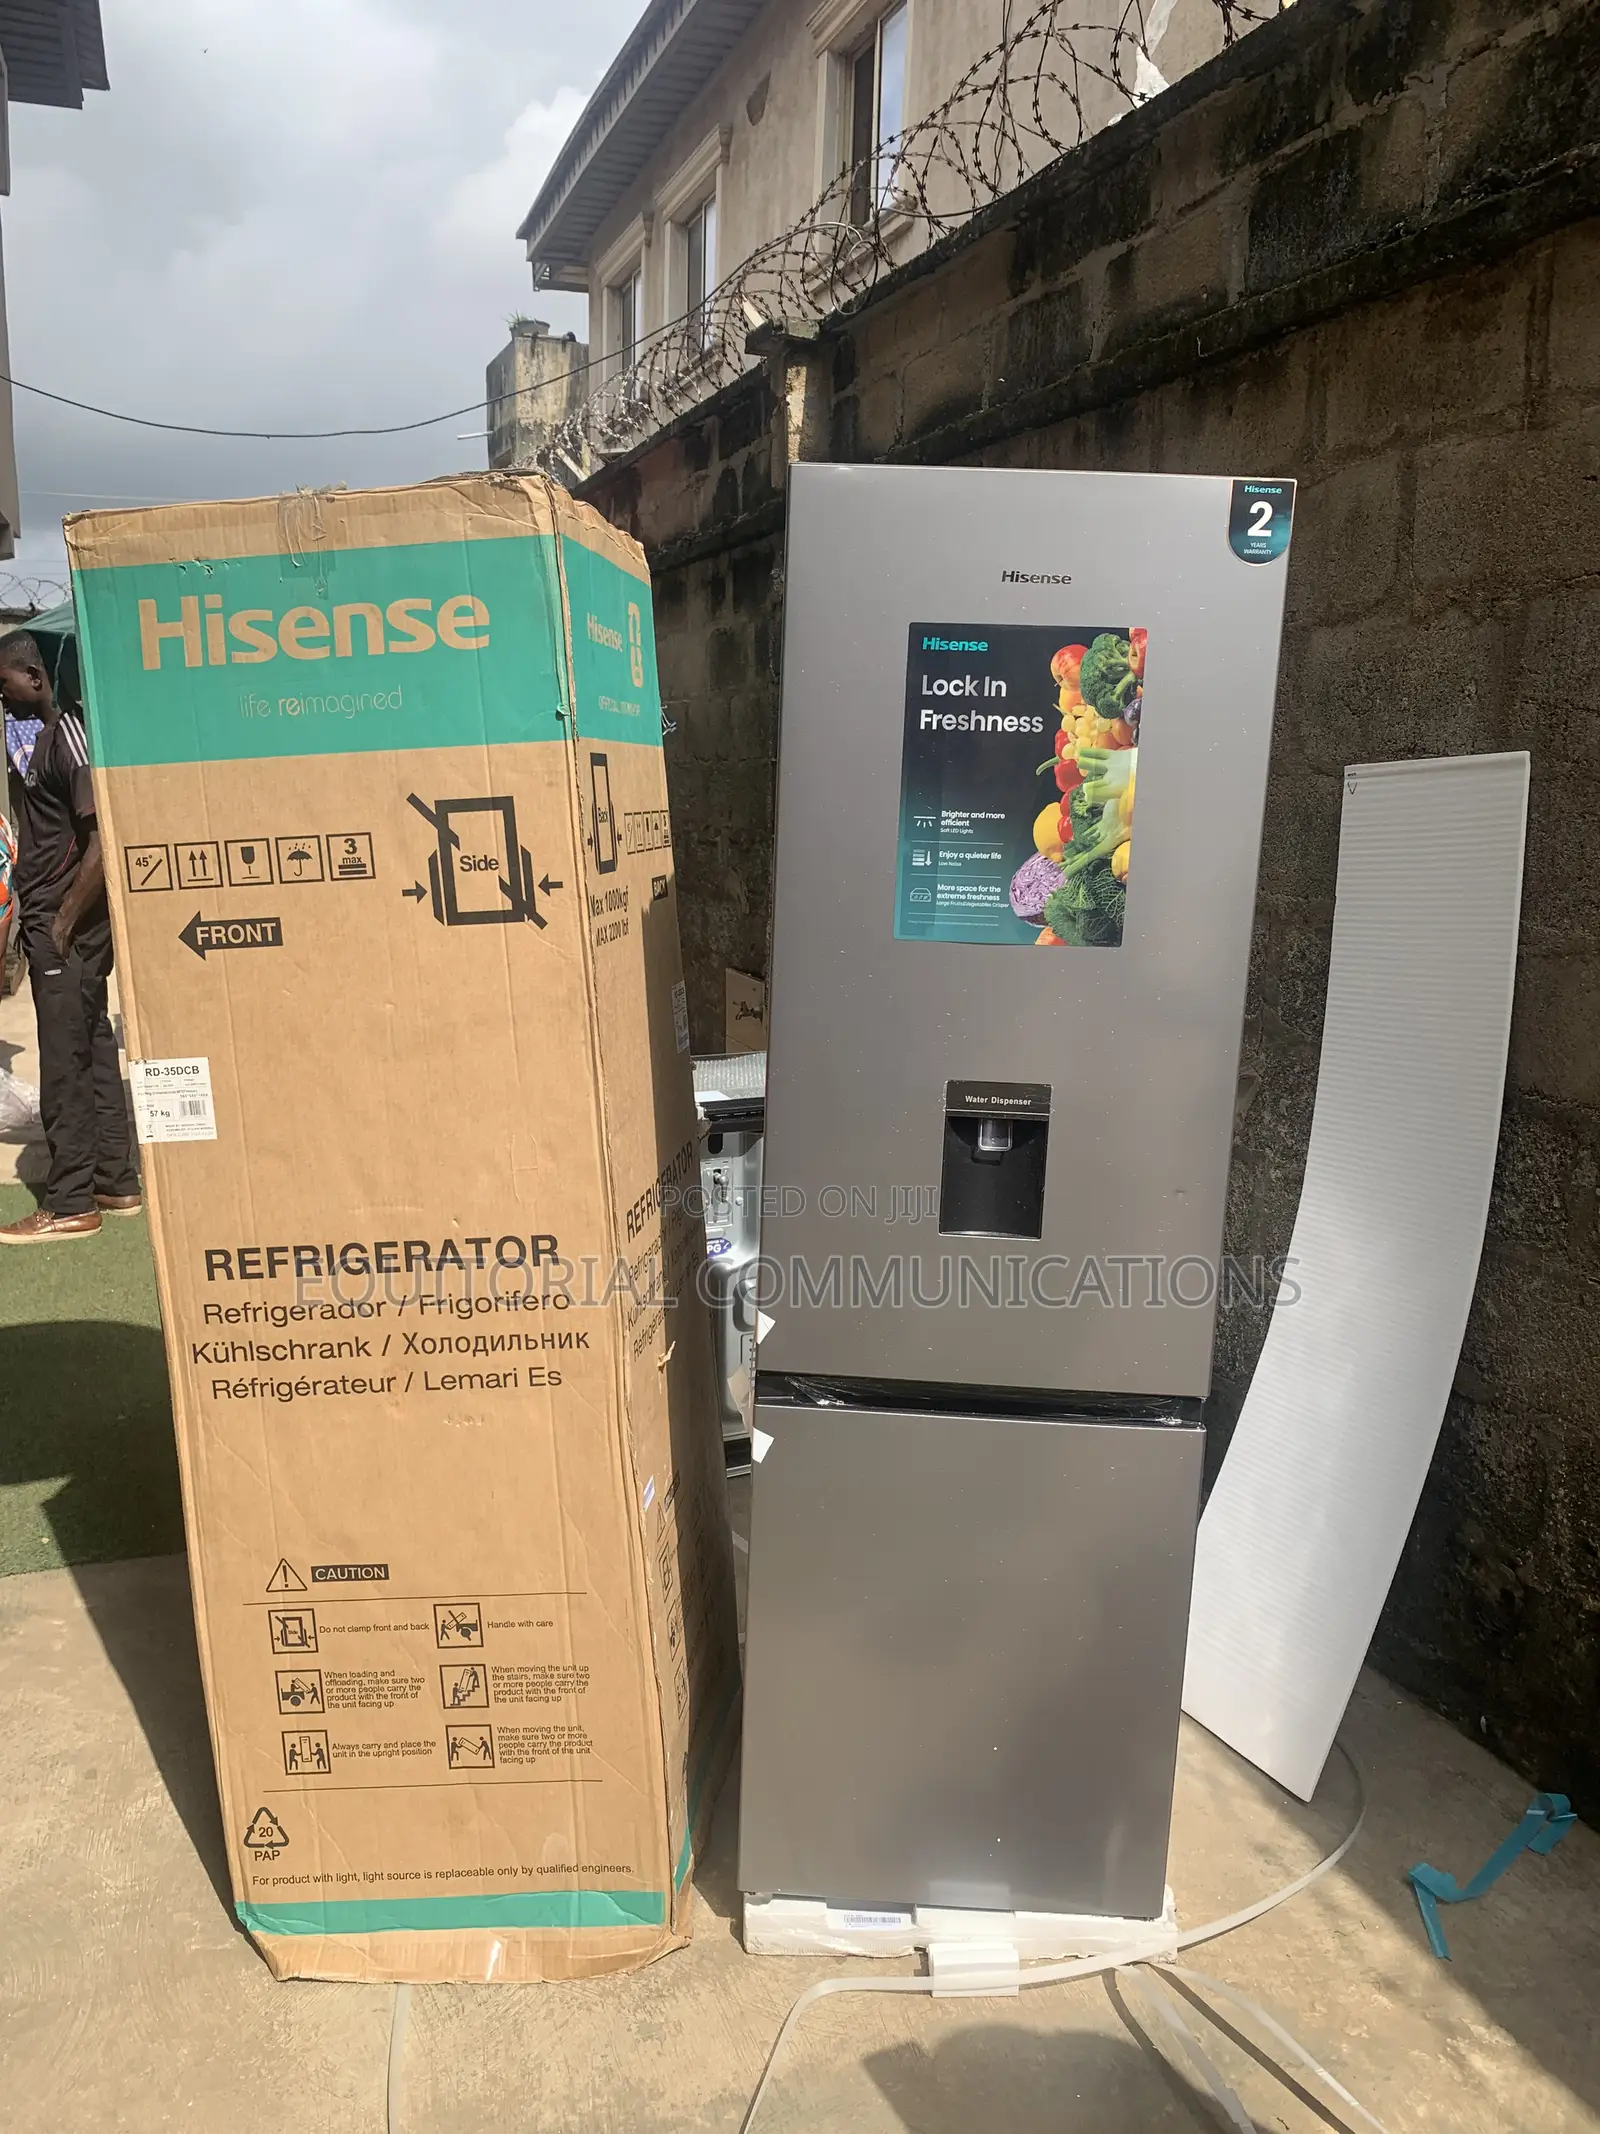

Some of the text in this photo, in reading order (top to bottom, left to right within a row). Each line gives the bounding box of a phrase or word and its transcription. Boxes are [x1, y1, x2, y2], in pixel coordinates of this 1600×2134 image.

[1245, 485, 1282, 494] Hisense
[1248, 501, 1273, 536] 2
[1002, 571, 1071, 584] Hisense
[139, 594, 490, 671] Hisense
[587, 612, 623, 652] Hisense
[923, 637, 988, 651] Hisense
[922, 675, 1007, 697] Lock In
[240, 685, 402, 720] life reimagined
[920, 710, 1043, 732] Freshness
[942, 810, 970, 819] Brighter
[344, 838, 358, 855] 3
[342, 856, 362, 864] max
[939, 851, 958, 859] Enjoy
[965, 852, 990, 860] quieter
[460, 855, 499, 872] Side
[196, 923, 276, 946] FRONT
[145, 1066, 199, 1077] RD-35DCB
[965, 1095, 1031, 1105] Water Dispenser
[626, 1141, 693, 1244] REFRIGERATOR
[205, 1235, 560, 1281] REFRIGERATOR
[204, 1290, 570, 1327] Refrigerador / Frigorifero
[192, 1332, 590, 1364] Kühlschrank / Холодильник
[212, 1367, 562, 1402] Réfrigérateur / Lemari Es
[316, 1567, 385, 1580] CAUTION
[348, 1625, 371, 1633] clamp
[393, 1623, 408, 1631] and
[517, 1665, 545, 1673] moving
[327, 1694, 356, 1702] product
[494, 1689, 523, 1697] product
[526, 1695, 549, 1703] facing
[359, 1701, 382, 1709] facing
[332, 1743, 359, 1751] Always
[401, 1741, 421, 1749] place
[373, 1749, 400, 1758] upright
[402, 1748, 432, 1757] position
[259, 1827, 273, 1838] 20
[254, 1850, 280, 1861] PAP
[253, 1863, 634, 1886] For product with light, light source is replaceable only by qualified engineers.
